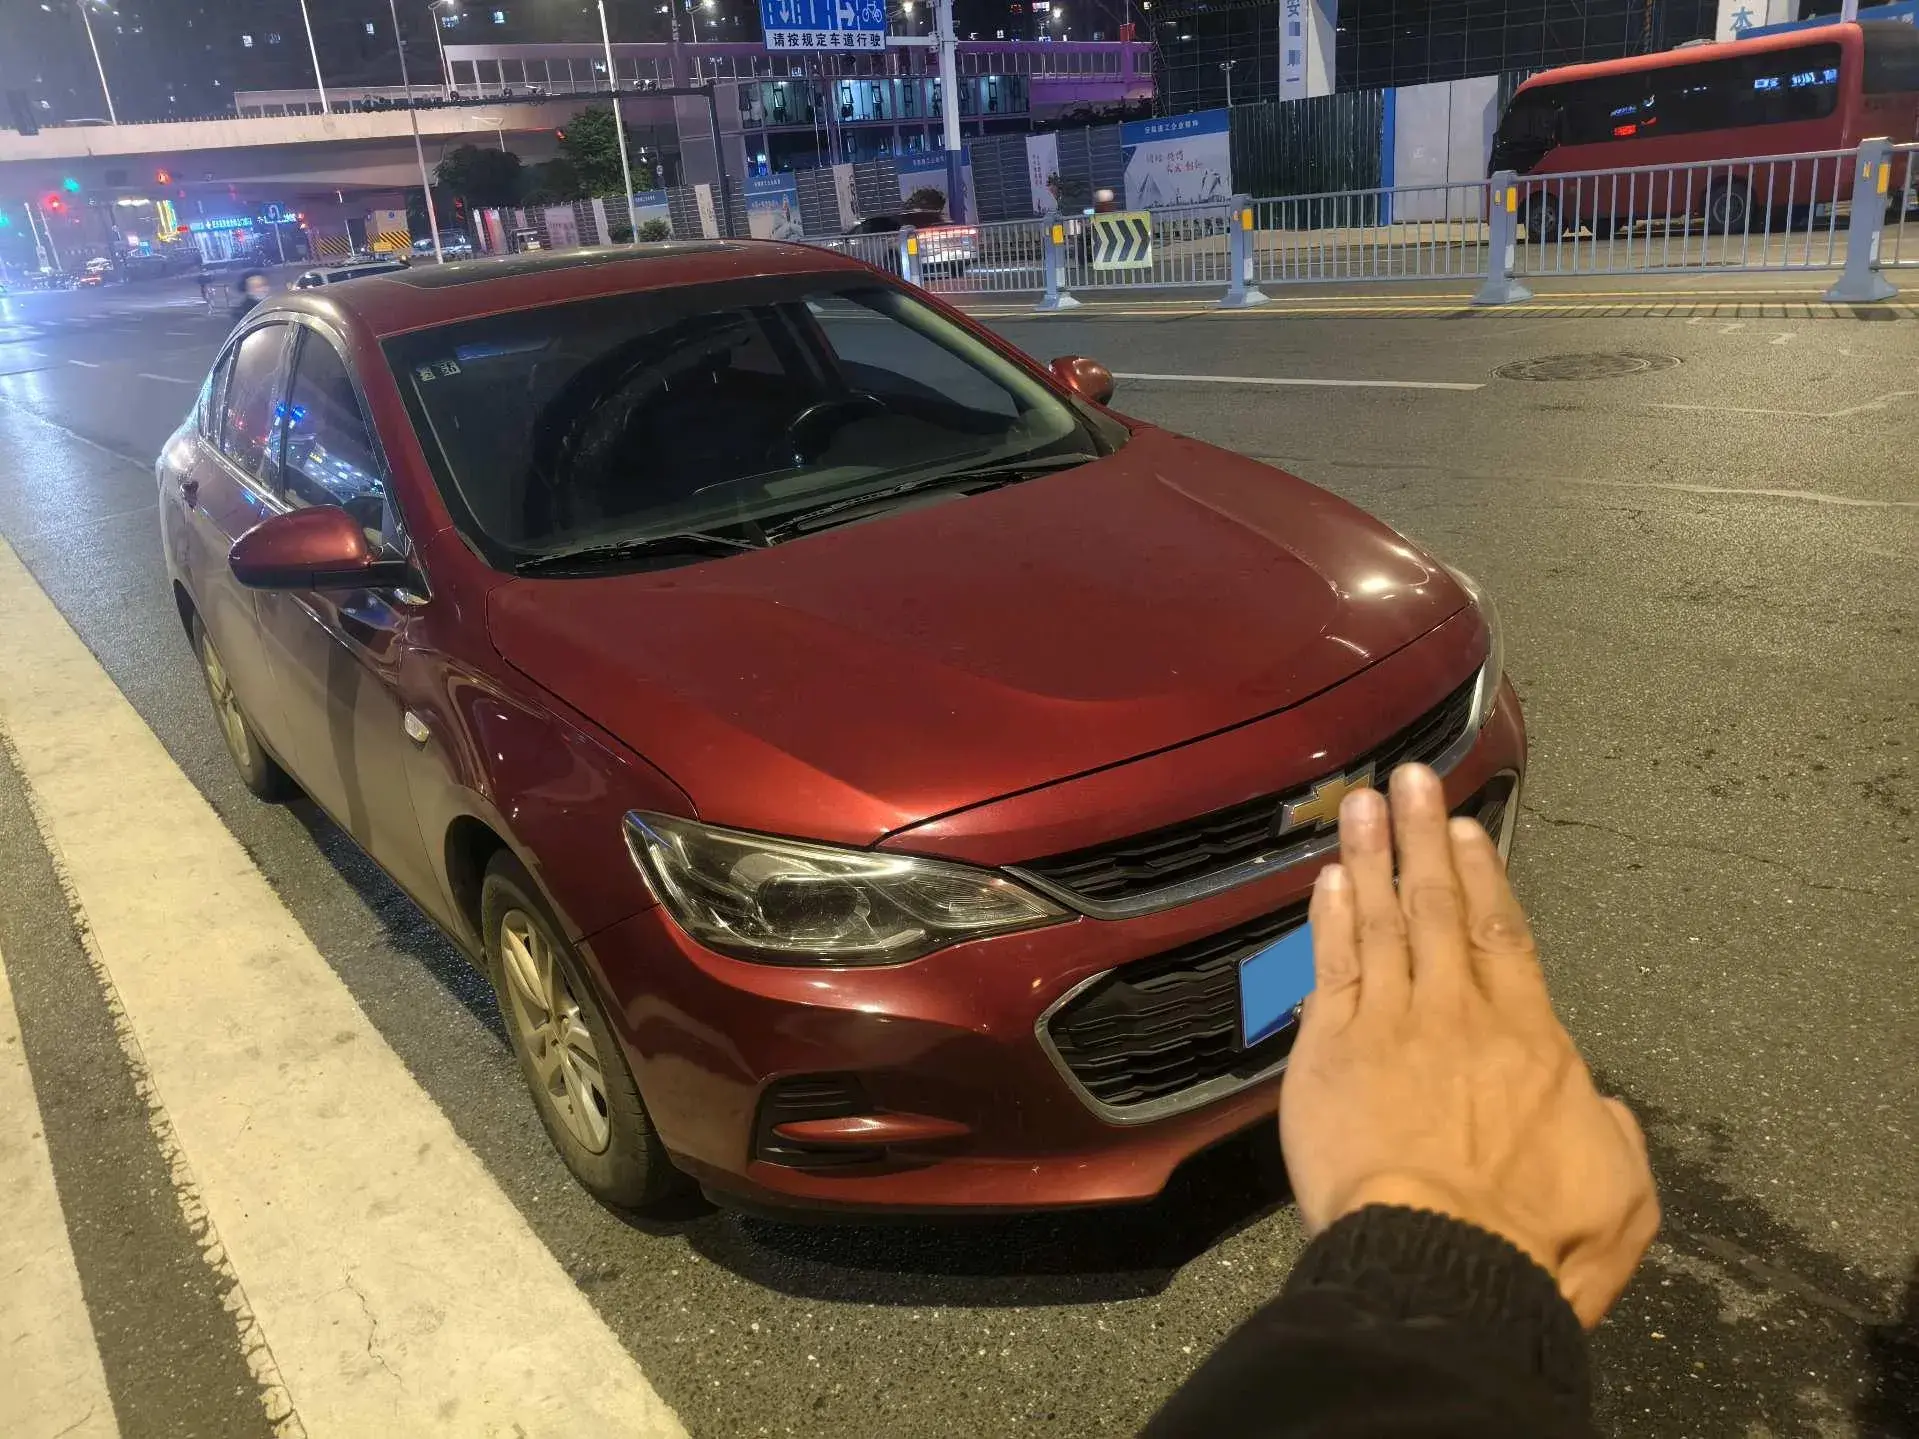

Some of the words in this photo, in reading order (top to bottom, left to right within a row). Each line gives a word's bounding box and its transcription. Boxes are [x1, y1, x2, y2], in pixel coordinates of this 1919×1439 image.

[774, 33, 881, 47] 请按规定车道行驶
